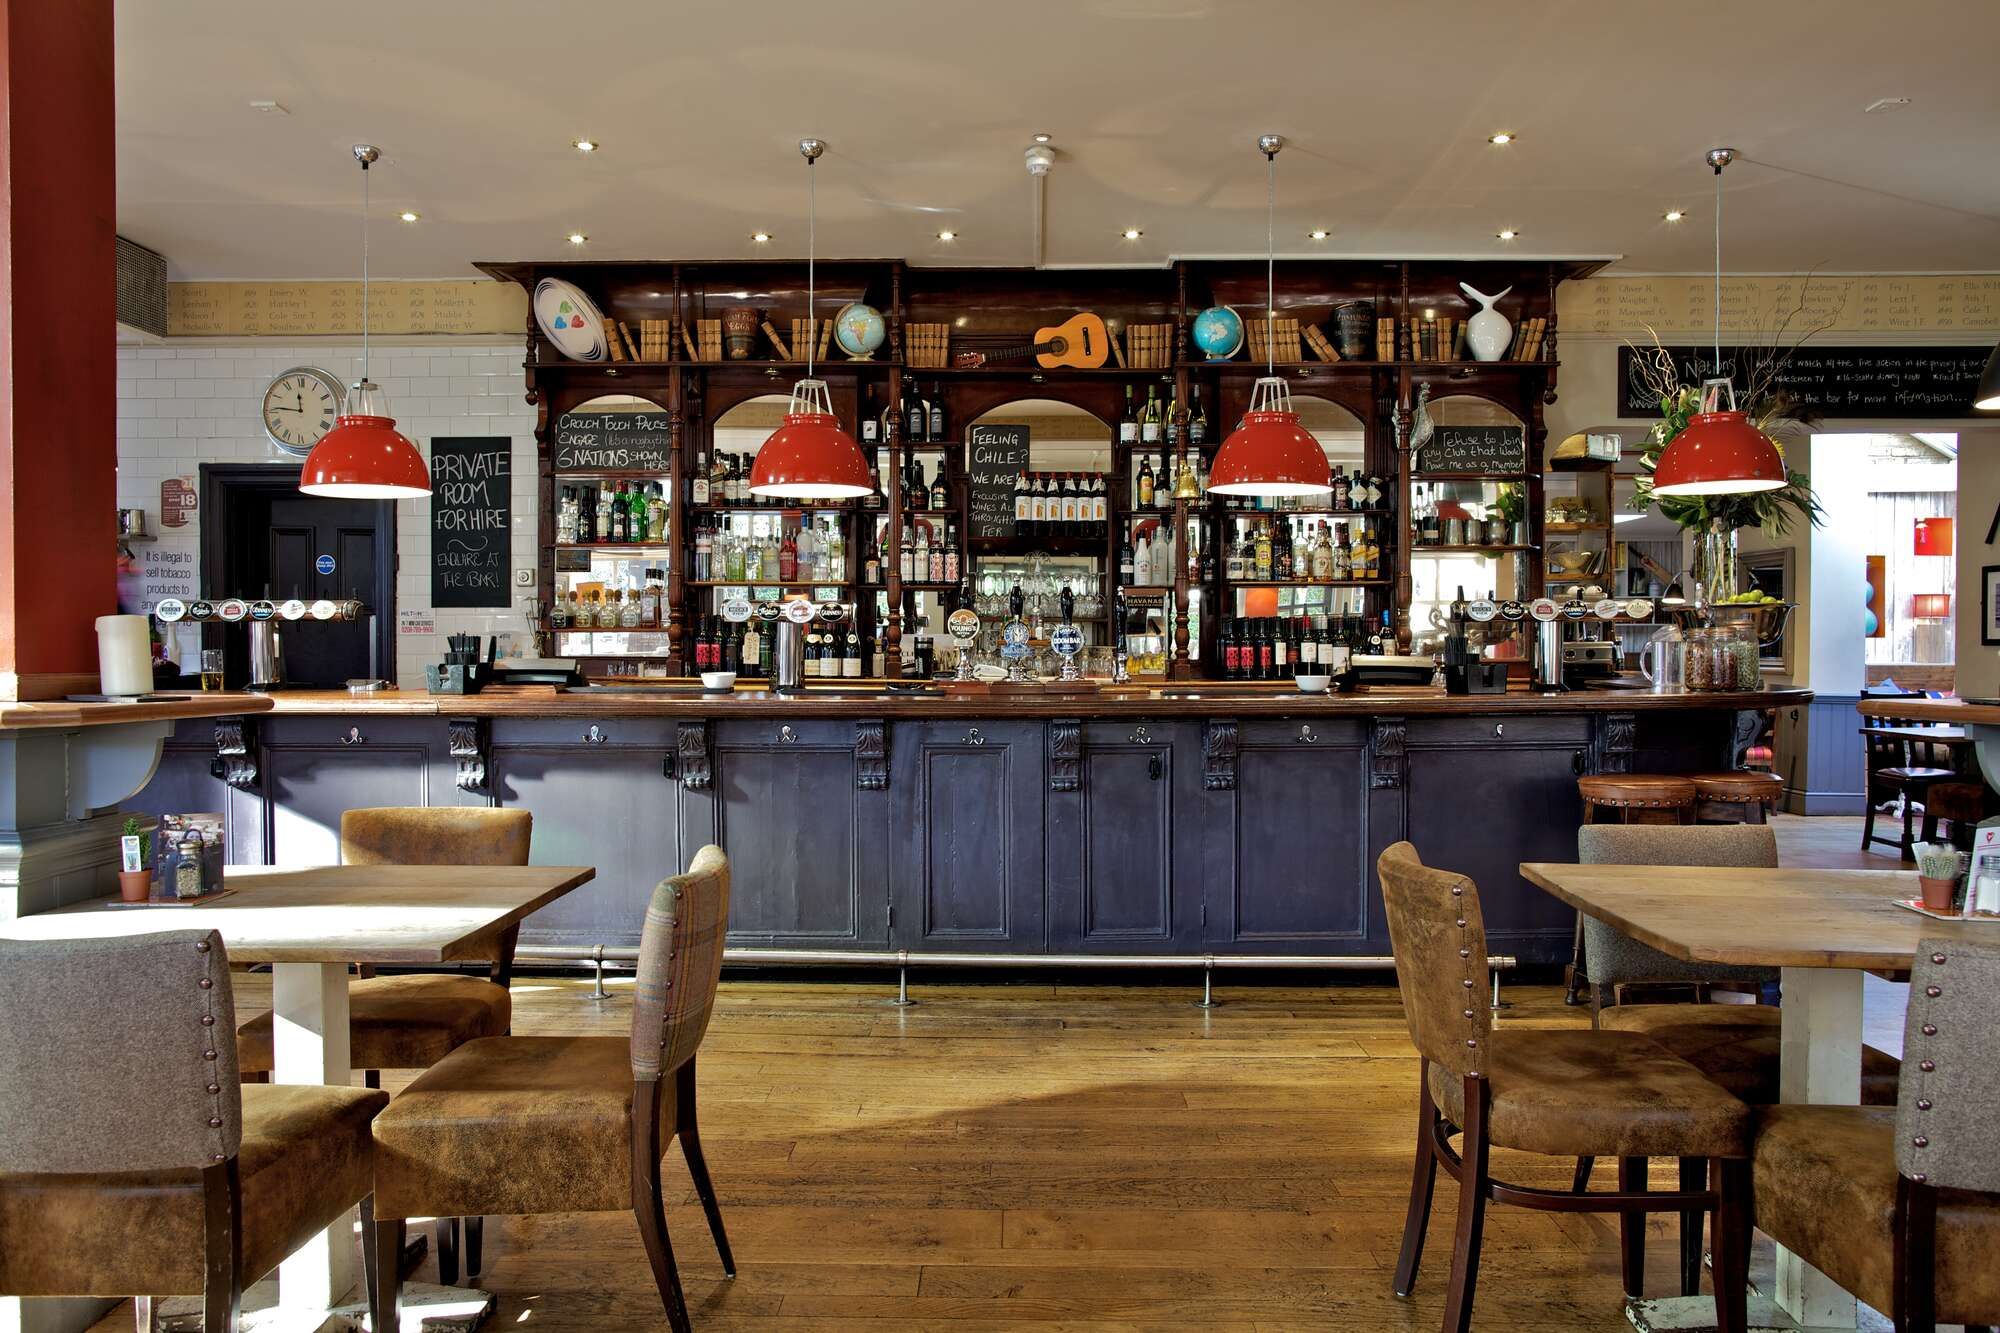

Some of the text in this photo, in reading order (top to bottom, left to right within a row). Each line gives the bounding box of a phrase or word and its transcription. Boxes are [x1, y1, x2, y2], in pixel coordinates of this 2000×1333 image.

[1836, 359, 1853, 367] the
[1916, 358, 1928, 367] the
[1804, 393, 1820, 404] the
[1826, 391, 1841, 403] bar
[972, 426, 1019, 446] FEELING
[1484, 431, 1497, 444] to
[556, 446, 664, 468] 6 NATIONS SHOWN
[974, 446, 1029, 464] CHILE?
[1422, 449, 1442, 462] any
[432, 451, 511, 480] PRIVATE
[971, 471, 990, 484] WE
[180, 494, 196, 506] 18
[440, 480, 491, 507] ROOM
[970, 501, 1015, 512] WINES AL
[435, 508, 508, 531] FOR HIRE
[146, 551, 192, 565] It is illegal to
[437, 551, 501, 568] ENQUIRE AT
[145, 567, 191, 579] sell tobacco
[440, 570, 501, 589] THE BAR!
[146, 584, 190, 596] products to
